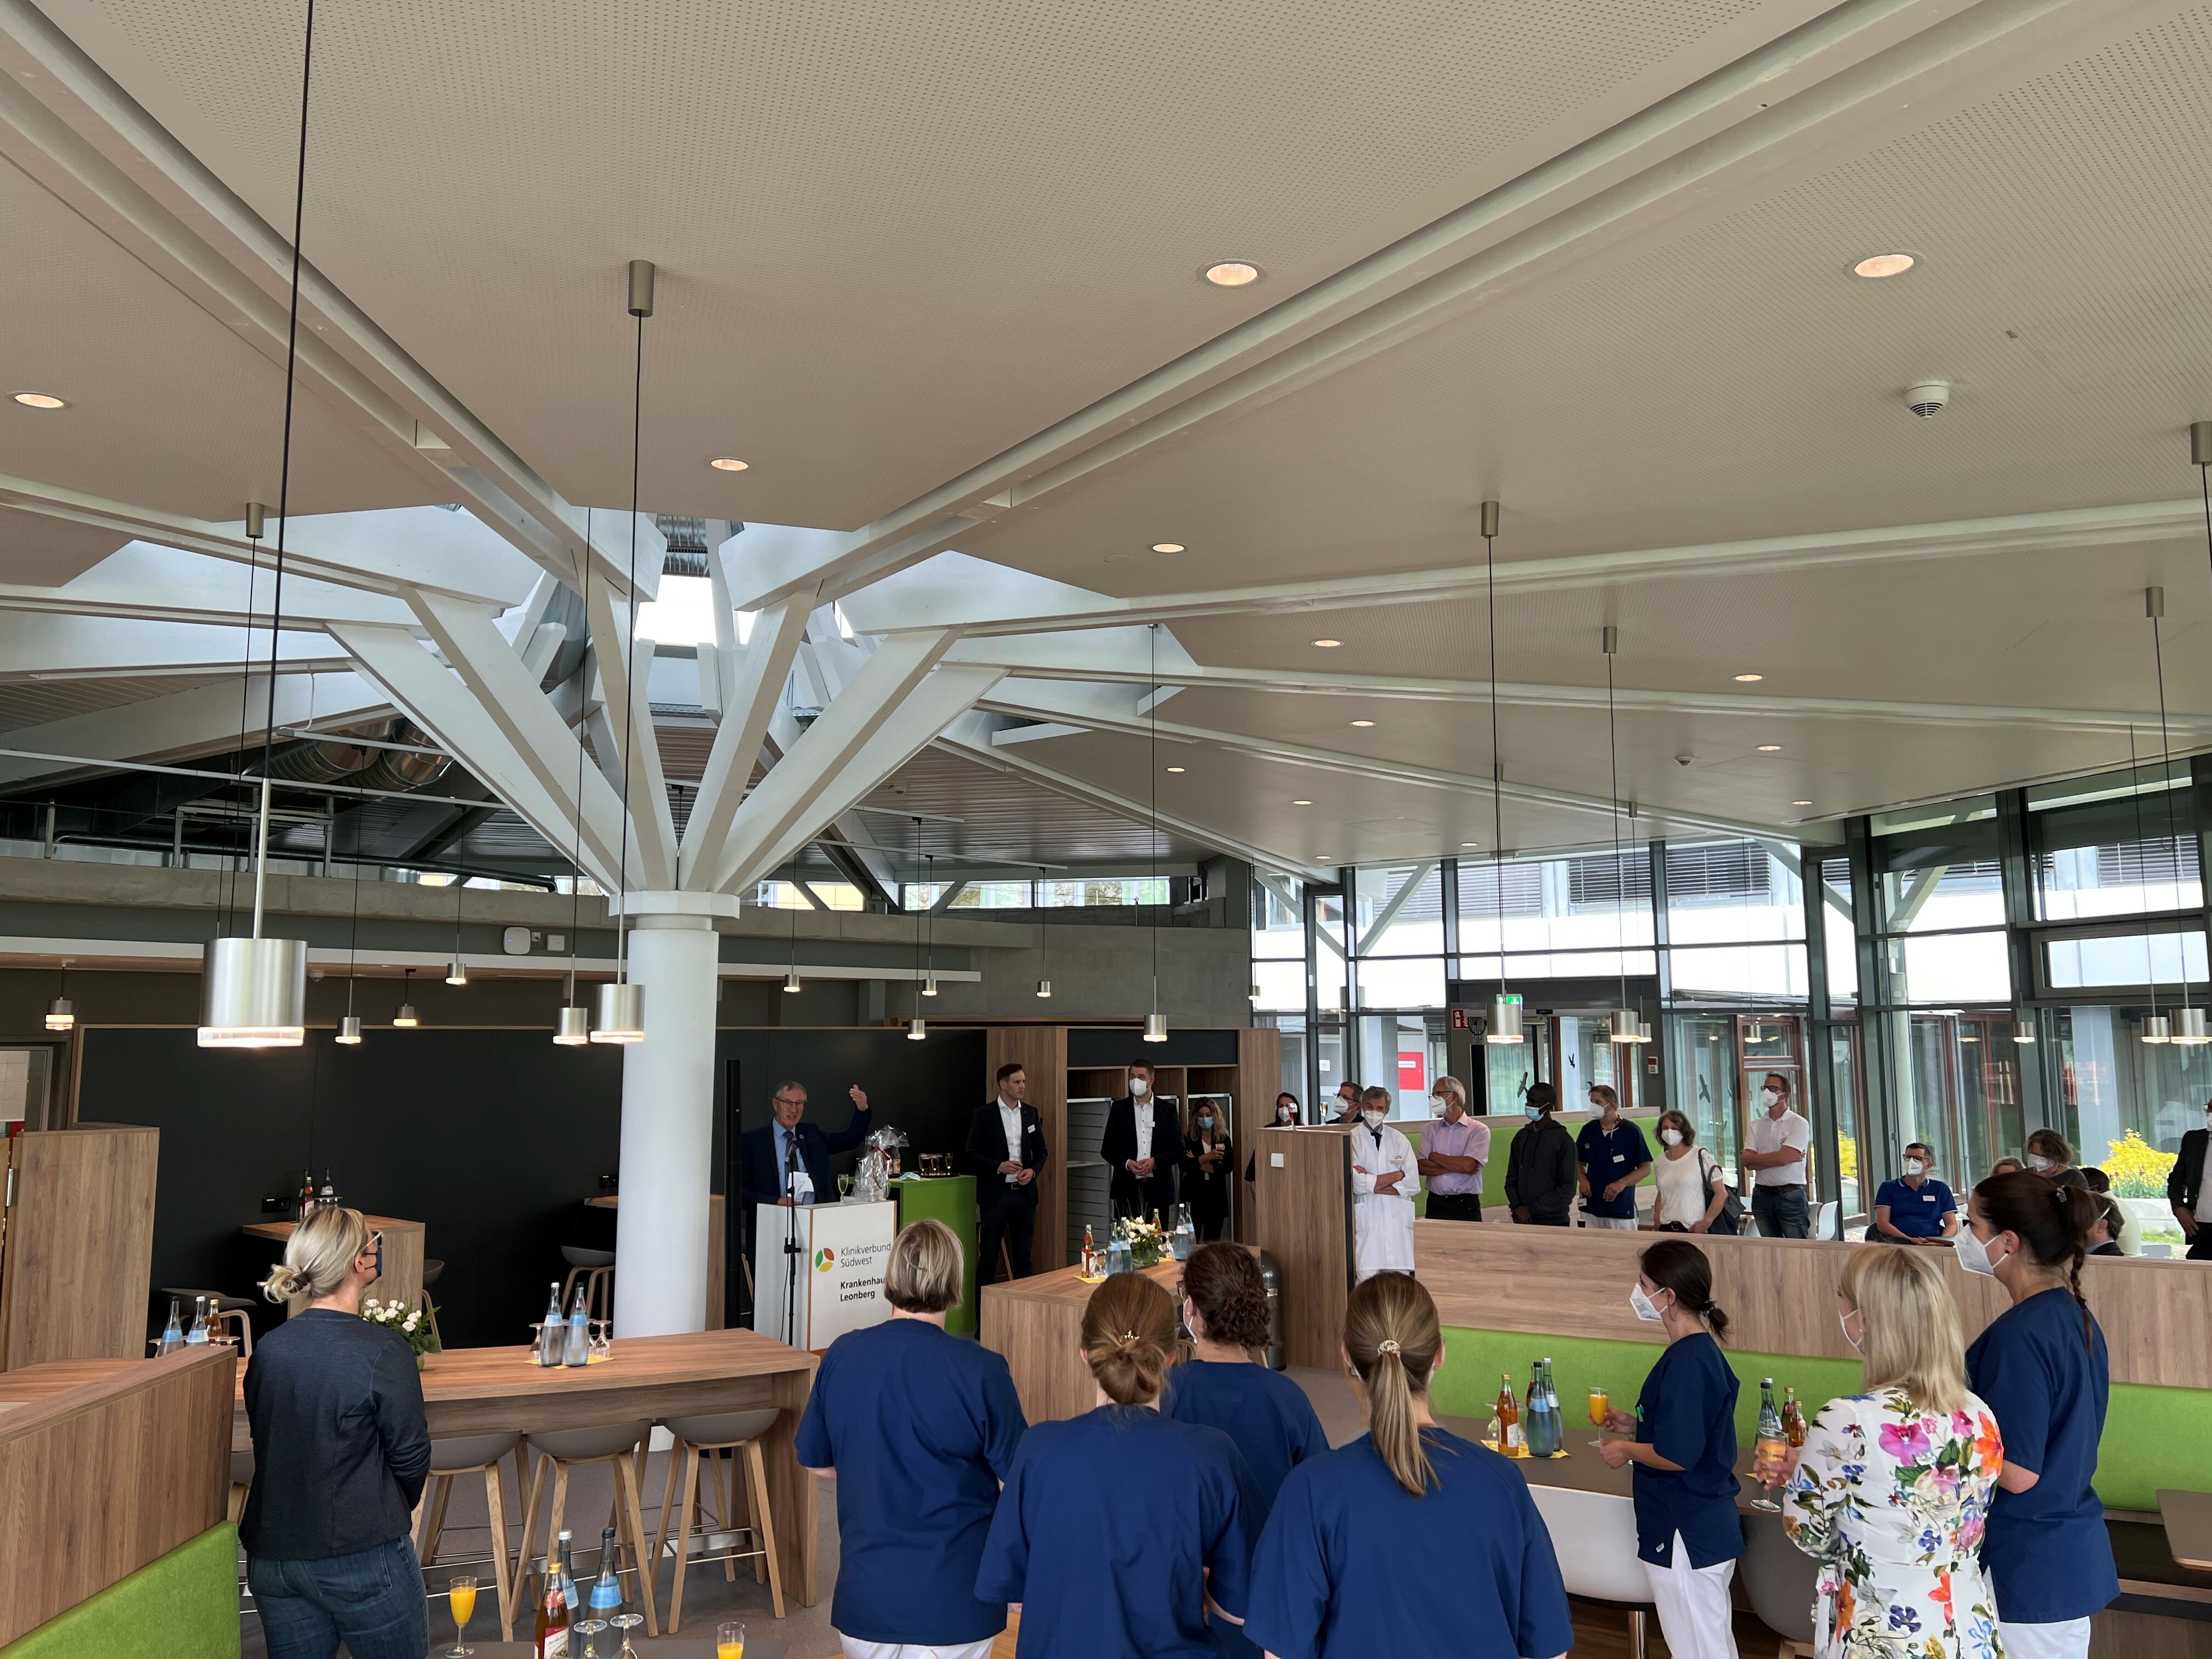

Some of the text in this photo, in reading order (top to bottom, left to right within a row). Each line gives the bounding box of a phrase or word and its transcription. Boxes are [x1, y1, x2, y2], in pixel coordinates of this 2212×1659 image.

[841, 1242, 891, 1256] Klinikverbund
[840, 1256, 872, 1268] Südwest
[840, 1277, 885, 1289] Krankenhau
[840, 1291, 875, 1301] Leonberg
